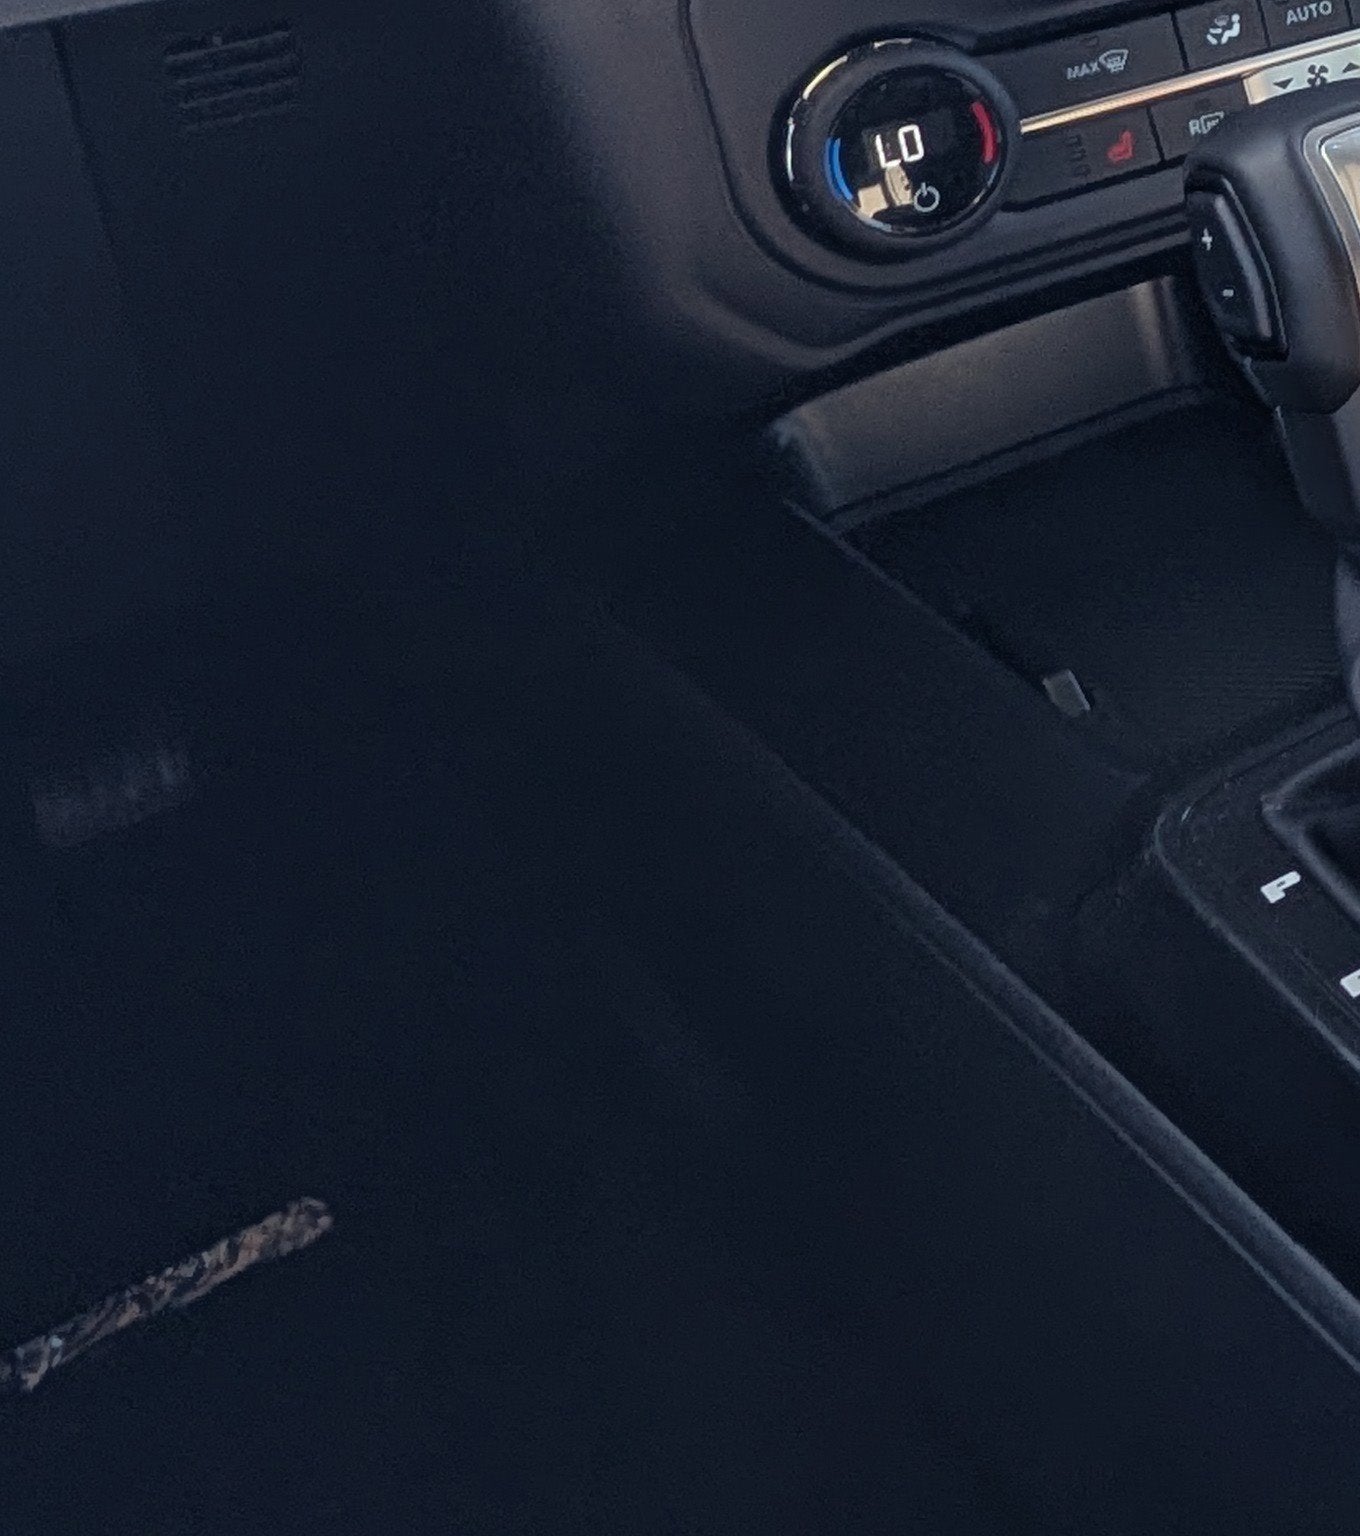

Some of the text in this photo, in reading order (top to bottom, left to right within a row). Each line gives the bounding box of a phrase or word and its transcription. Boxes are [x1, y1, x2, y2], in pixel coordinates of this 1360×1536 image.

[1285, 0, 1333, 25] AUTO
[1067, 61, 1099, 80] MAX
[874, 124, 924, 167] LO
